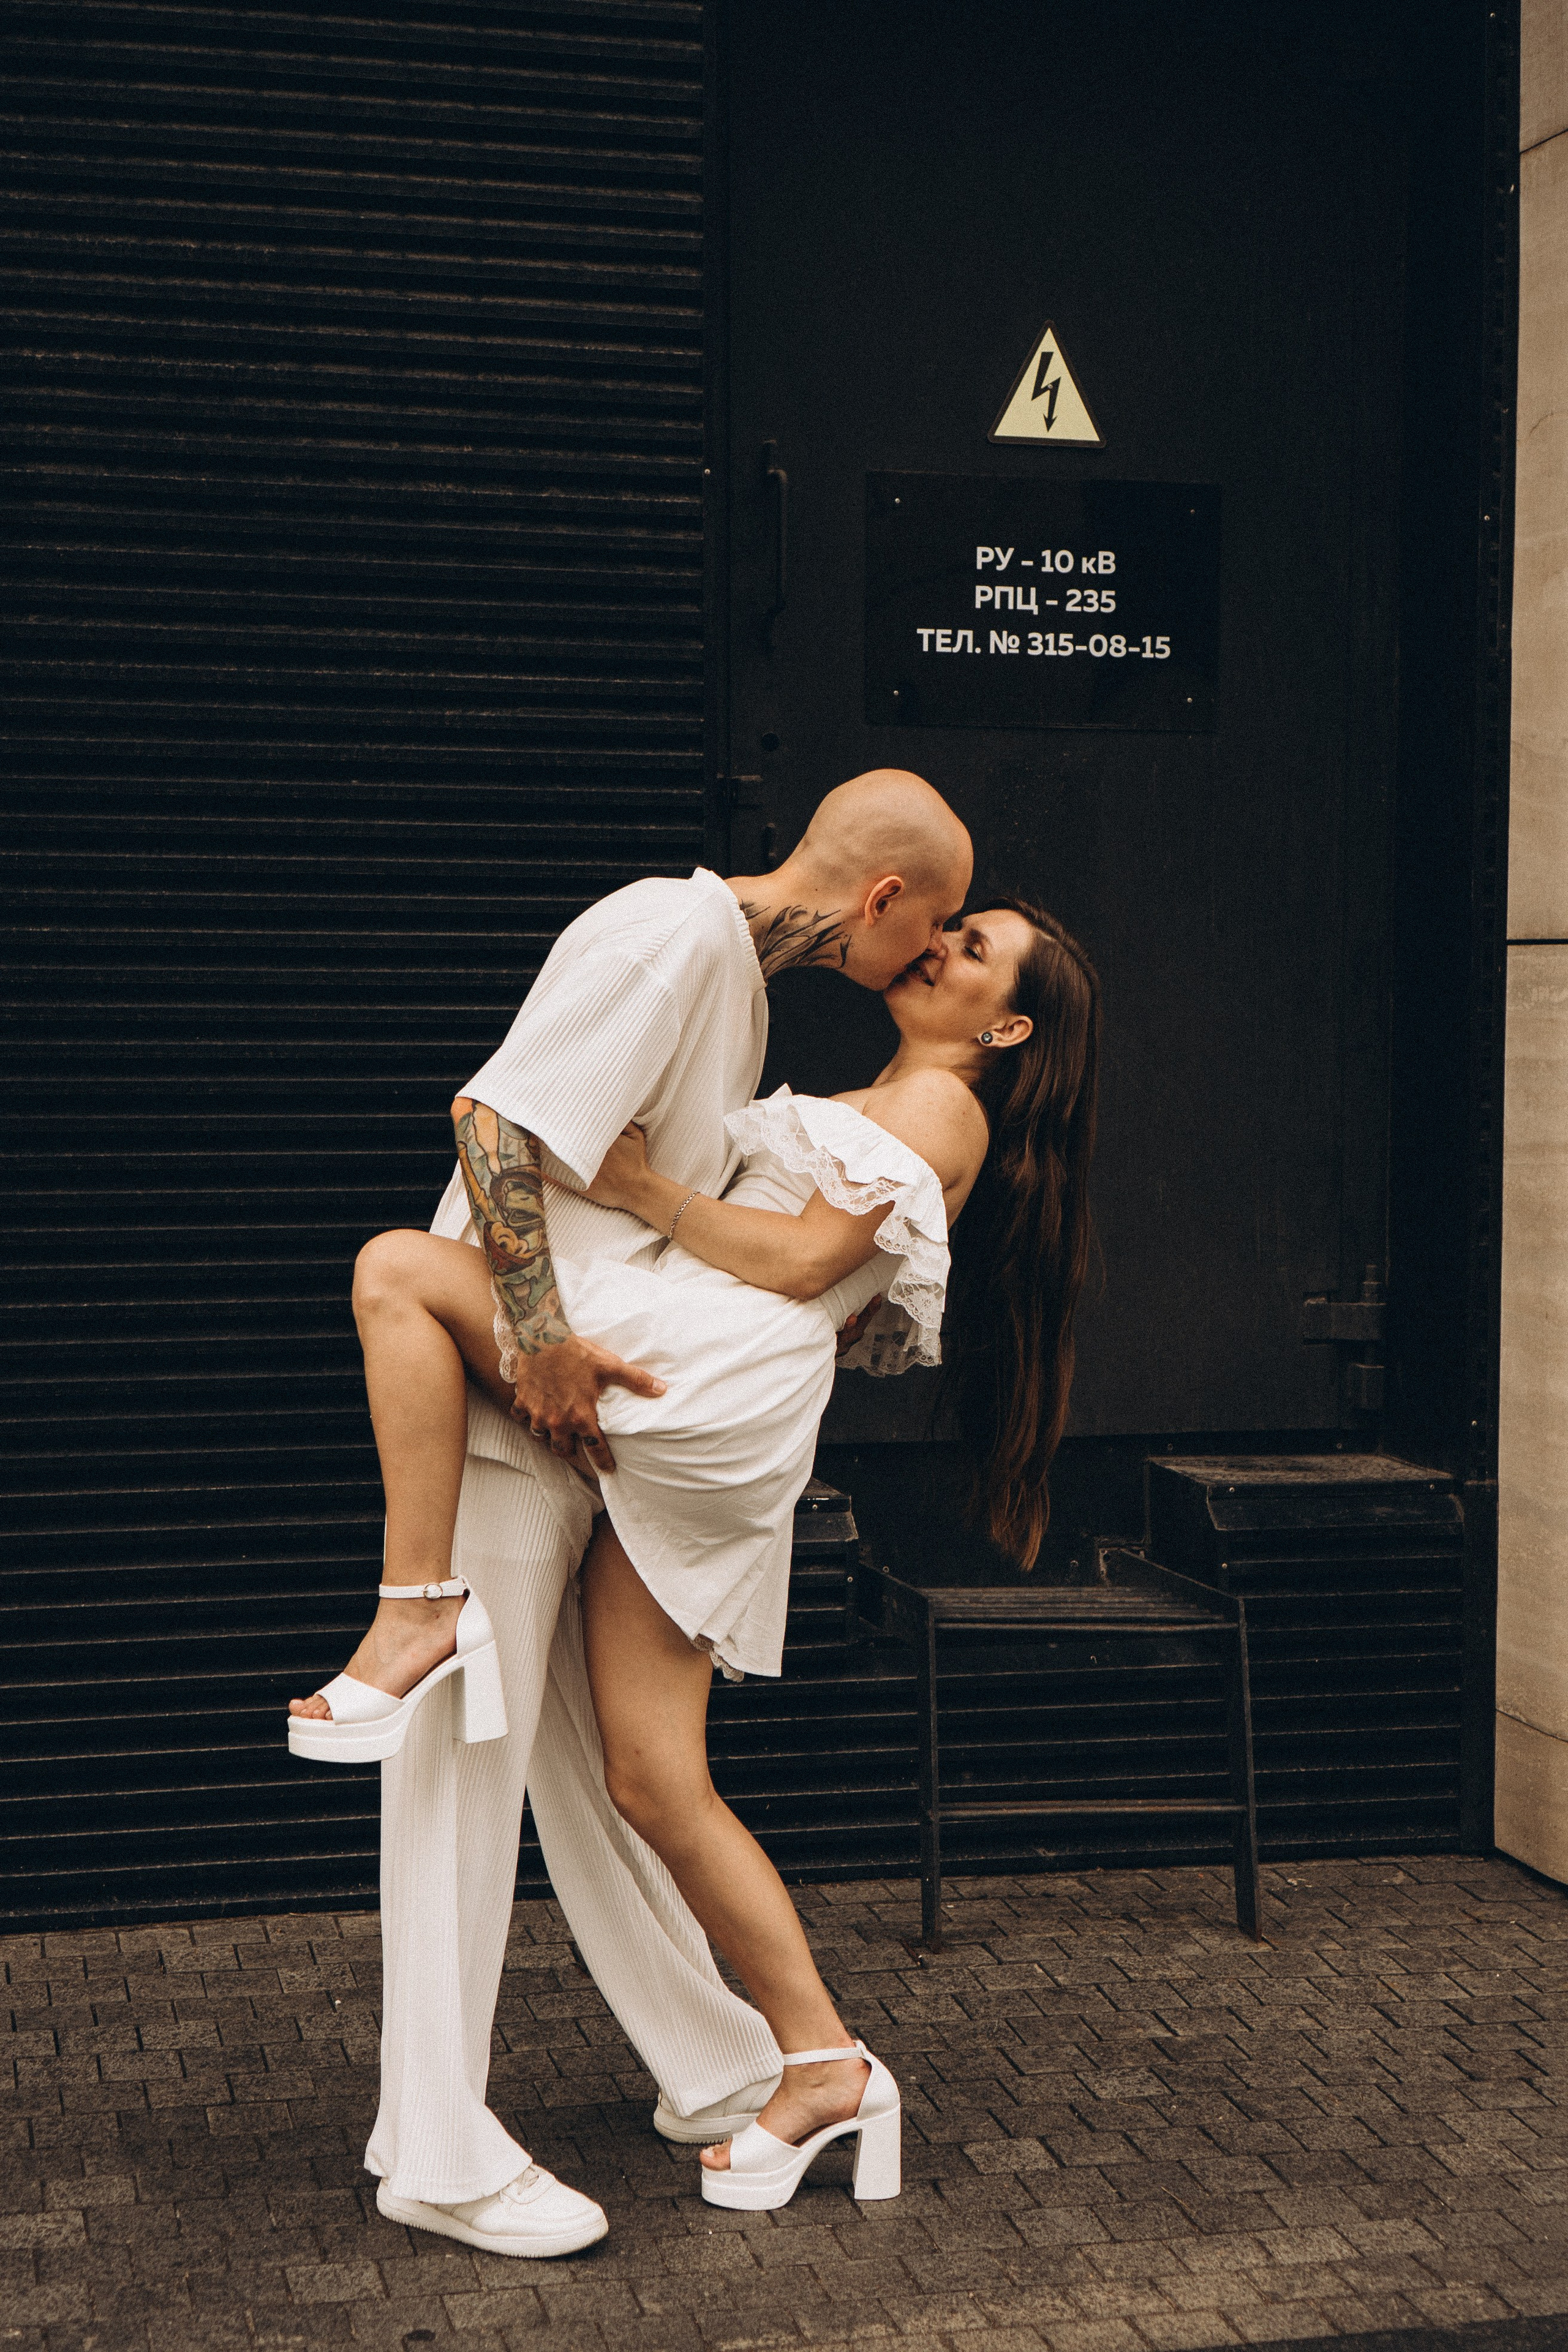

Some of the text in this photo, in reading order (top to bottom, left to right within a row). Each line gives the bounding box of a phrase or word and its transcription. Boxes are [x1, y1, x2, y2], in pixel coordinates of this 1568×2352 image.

[976, 546, 1015, 571] РУ
[1041, 549, 1074, 573] 10
[1081, 551, 1116, 575] кВ
[974, 585, 1039, 616] РПЦ
[1065, 589, 1116, 613] 235
[916, 628, 1170, 659] ТЕЛ. № 315-08-15
